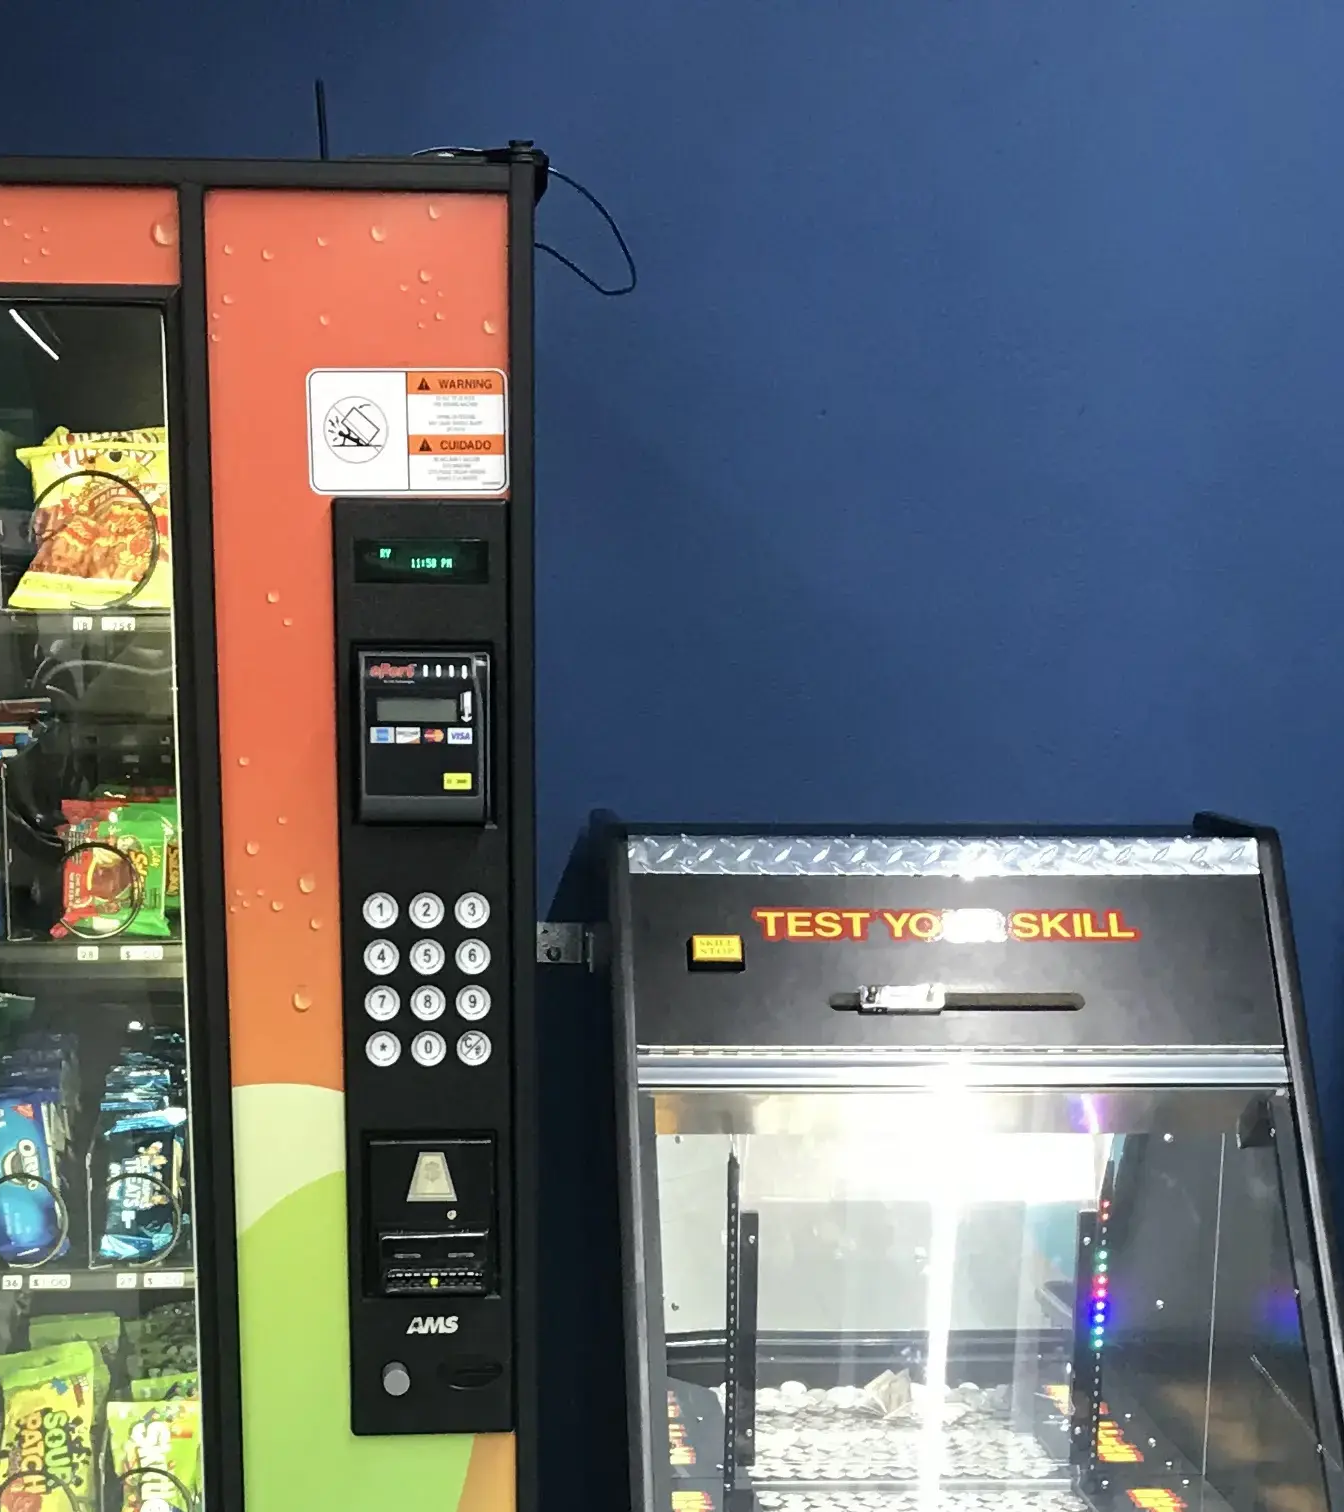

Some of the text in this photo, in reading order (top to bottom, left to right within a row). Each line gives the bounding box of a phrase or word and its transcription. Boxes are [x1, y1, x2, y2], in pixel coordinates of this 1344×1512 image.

[438, 379, 493, 389] WARNING
[440, 440, 492, 451] CUIDADO
[451, 732, 471, 741] VISA
[376, 903, 384, 916] 1
[422, 903, 431, 916] 2
[467, 903, 476, 916] 3
[755, 911, 871, 938] TEST
[1012, 911, 1136, 939] SKILL
[377, 949, 386, 963] 4
[423, 949, 432, 963] 5
[468, 948, 477, 962] 6
[378, 995, 387, 1008] 7
[423, 995, 432, 1008] 8
[468, 995, 477, 1008] 9
[424, 1040, 433, 1054] 0
[5, 1278, 19, 1288] 36
[406, 1316, 459, 1335] AMS
[19, 1410, 48, 1495] PATCH
